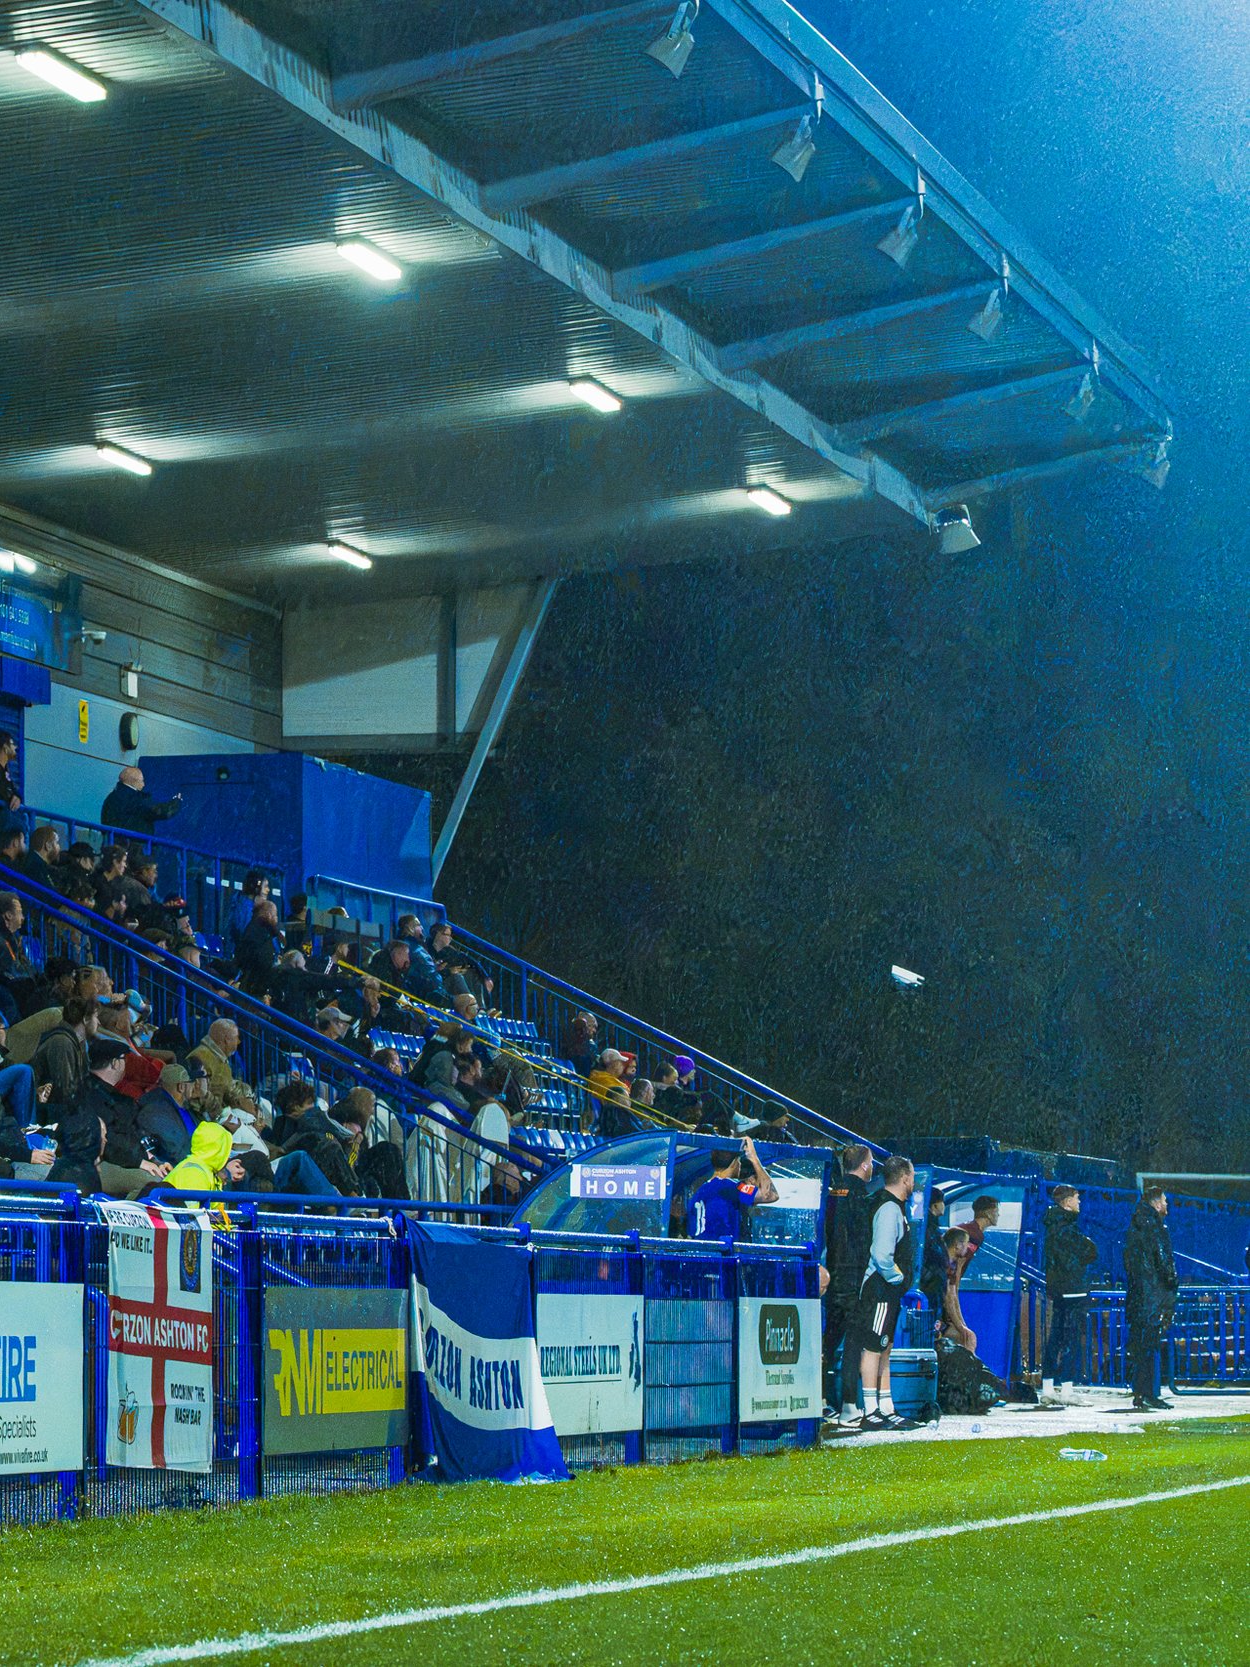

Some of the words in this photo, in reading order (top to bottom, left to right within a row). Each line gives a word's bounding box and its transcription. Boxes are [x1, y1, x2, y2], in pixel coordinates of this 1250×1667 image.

[586, 1180, 656, 1196] HOME
[110, 1309, 151, 1346] CRZON
[152, 1316, 196, 1353] ASHTON
[196, 1322, 209, 1354] FC
[326, 1349, 403, 1392] ELECTRICAL
[573, 1345, 597, 1377] STEELS
[469, 1355, 525, 1411] ASHTON
